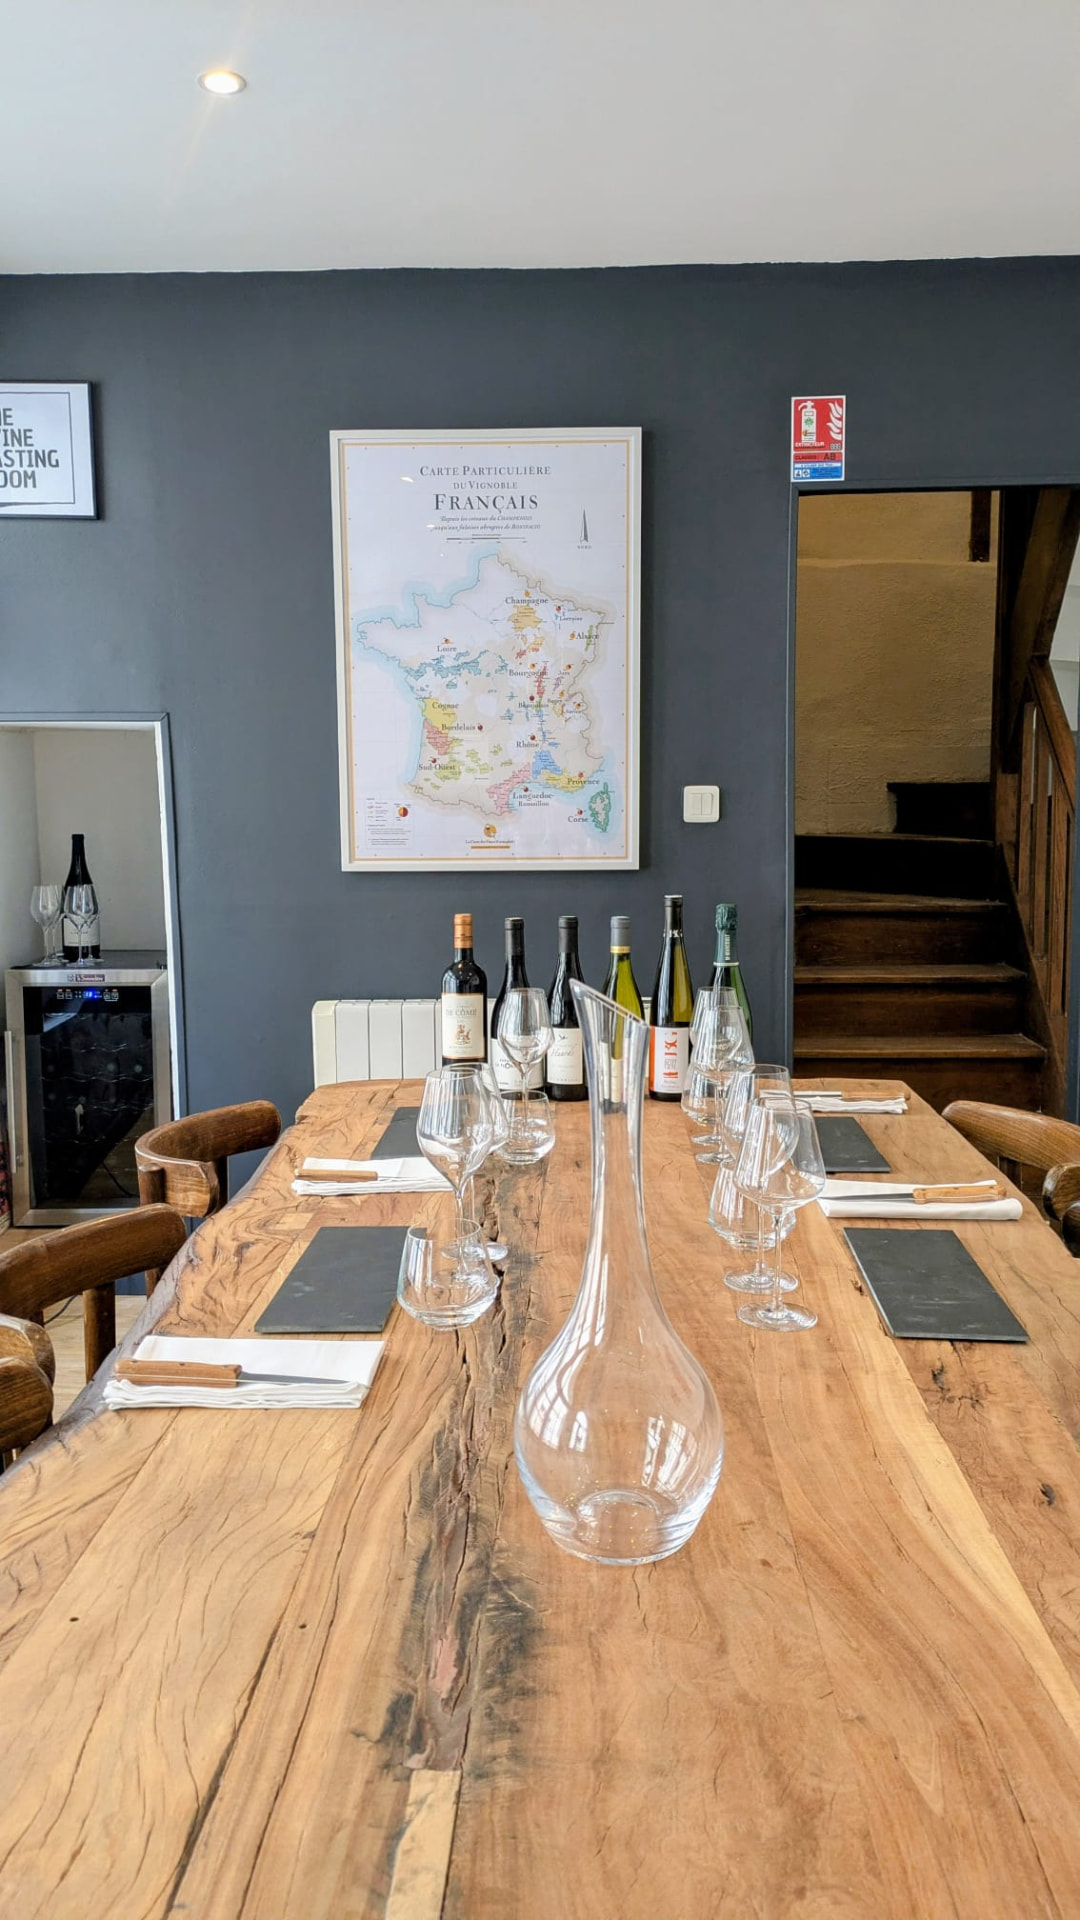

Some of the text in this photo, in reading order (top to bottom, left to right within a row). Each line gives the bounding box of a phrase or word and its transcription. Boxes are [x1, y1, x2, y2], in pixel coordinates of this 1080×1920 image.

[0, 428, 34, 447] INE
[420, 466, 551, 476] CARTE PARTICULIÈRE
[453, 480, 518, 490] DU VIGNOBLE
[433, 493, 539, 513] FRANÇAIS
[505, 596, 549, 606] Champagne
[432, 701, 459, 712] Cognac
[441, 723, 476, 731] Bordelais
[418, 763, 456, 771] Sud-Ouest
[567, 778, 600, 786] Provence
[568, 815, 588, 823] Corse
